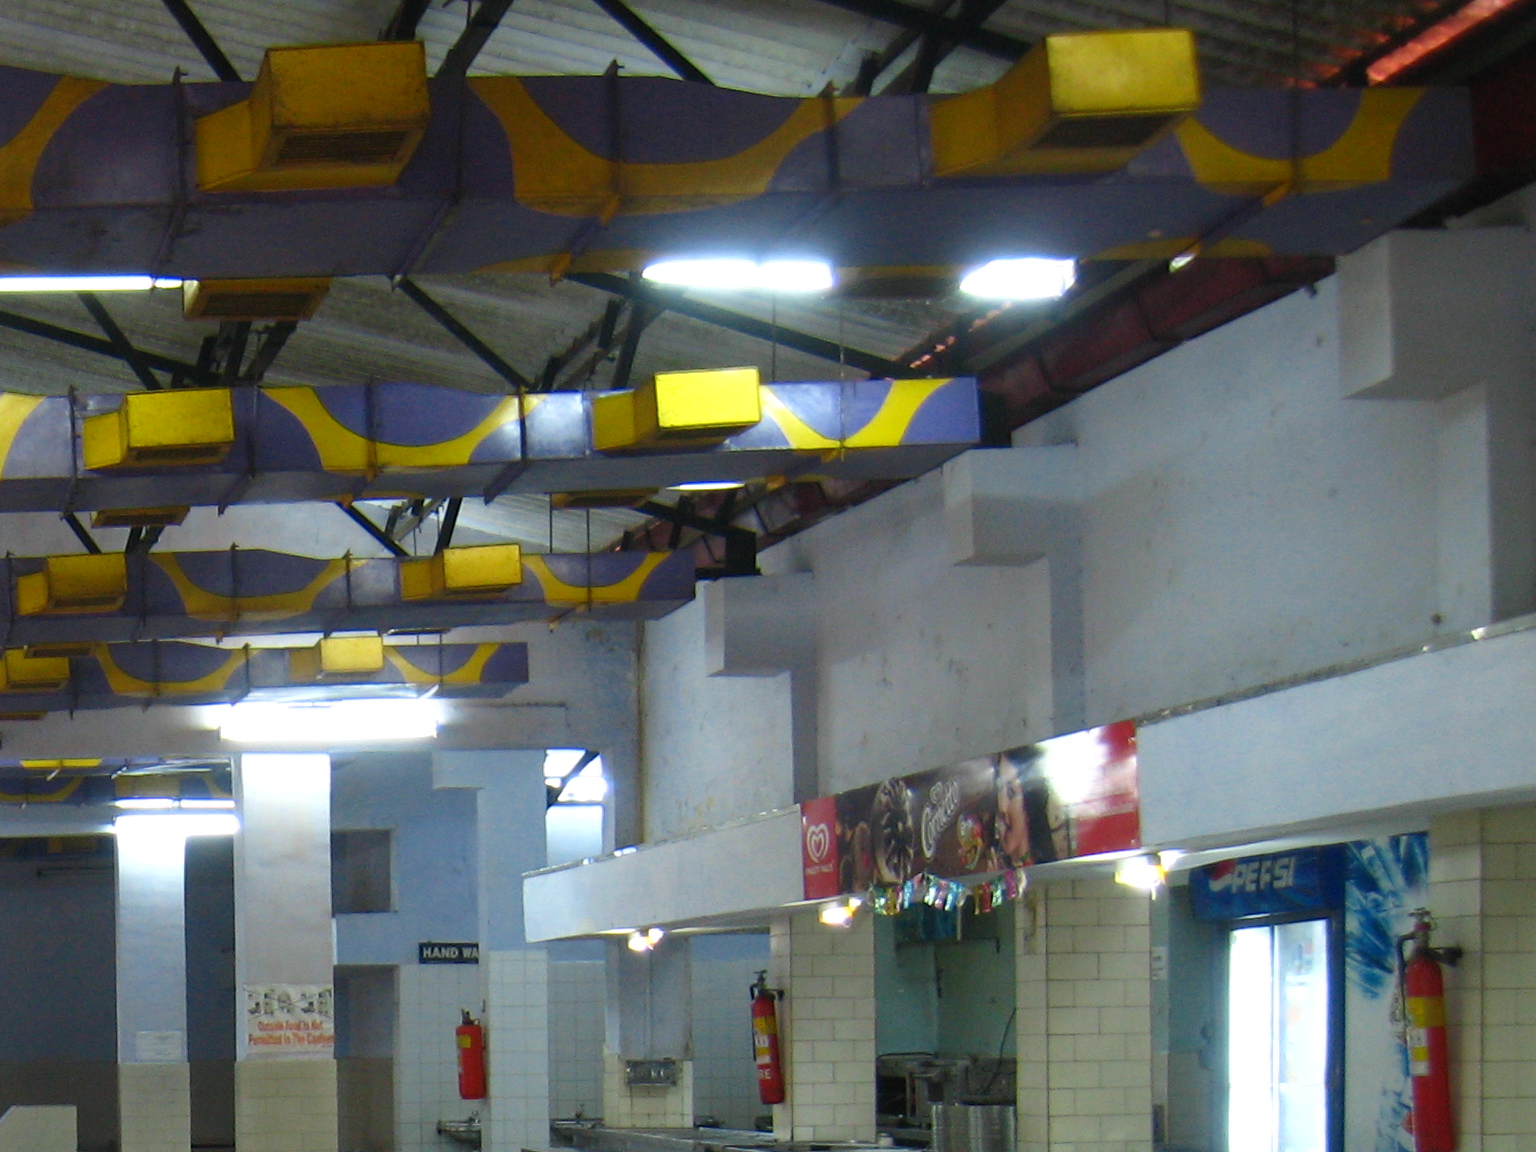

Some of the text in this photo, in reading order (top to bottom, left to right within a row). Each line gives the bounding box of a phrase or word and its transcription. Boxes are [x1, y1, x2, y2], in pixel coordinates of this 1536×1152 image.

[1231, 856, 1295, 893] PEPSI
[422, 946, 479, 959] HAND WA
